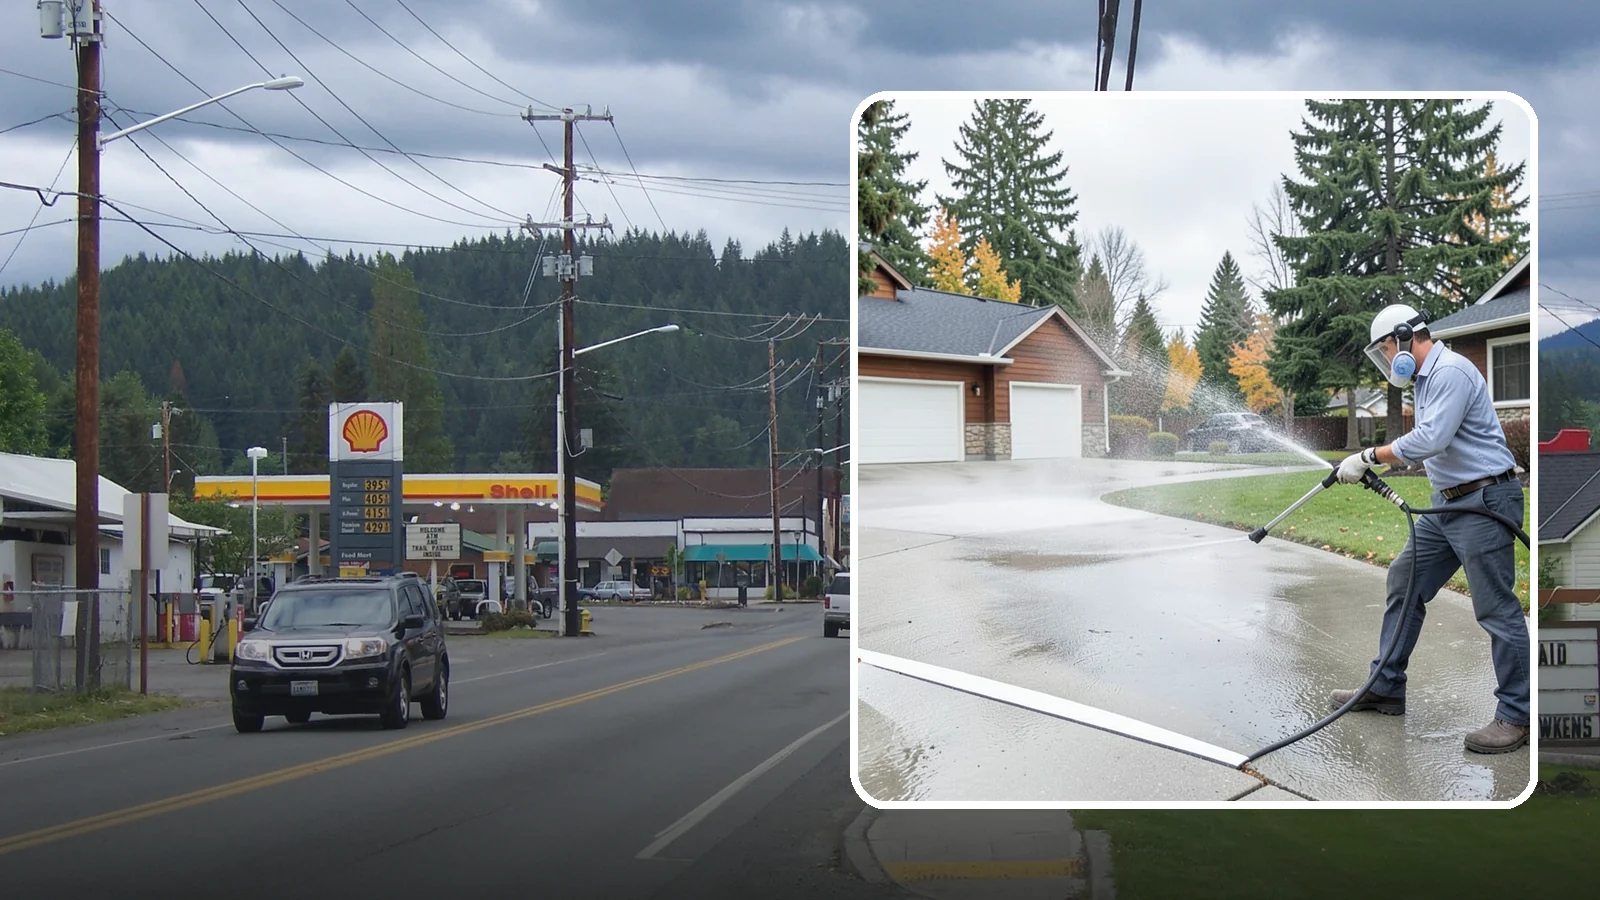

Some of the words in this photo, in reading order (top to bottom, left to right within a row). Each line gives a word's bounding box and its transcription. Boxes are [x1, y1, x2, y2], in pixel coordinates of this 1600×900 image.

[366, 480, 383, 490] 395
[490, 484, 547, 499] Shell
[366, 494, 383, 504] 405
[366, 508, 383, 518] 415
[366, 522, 383, 532] 429
